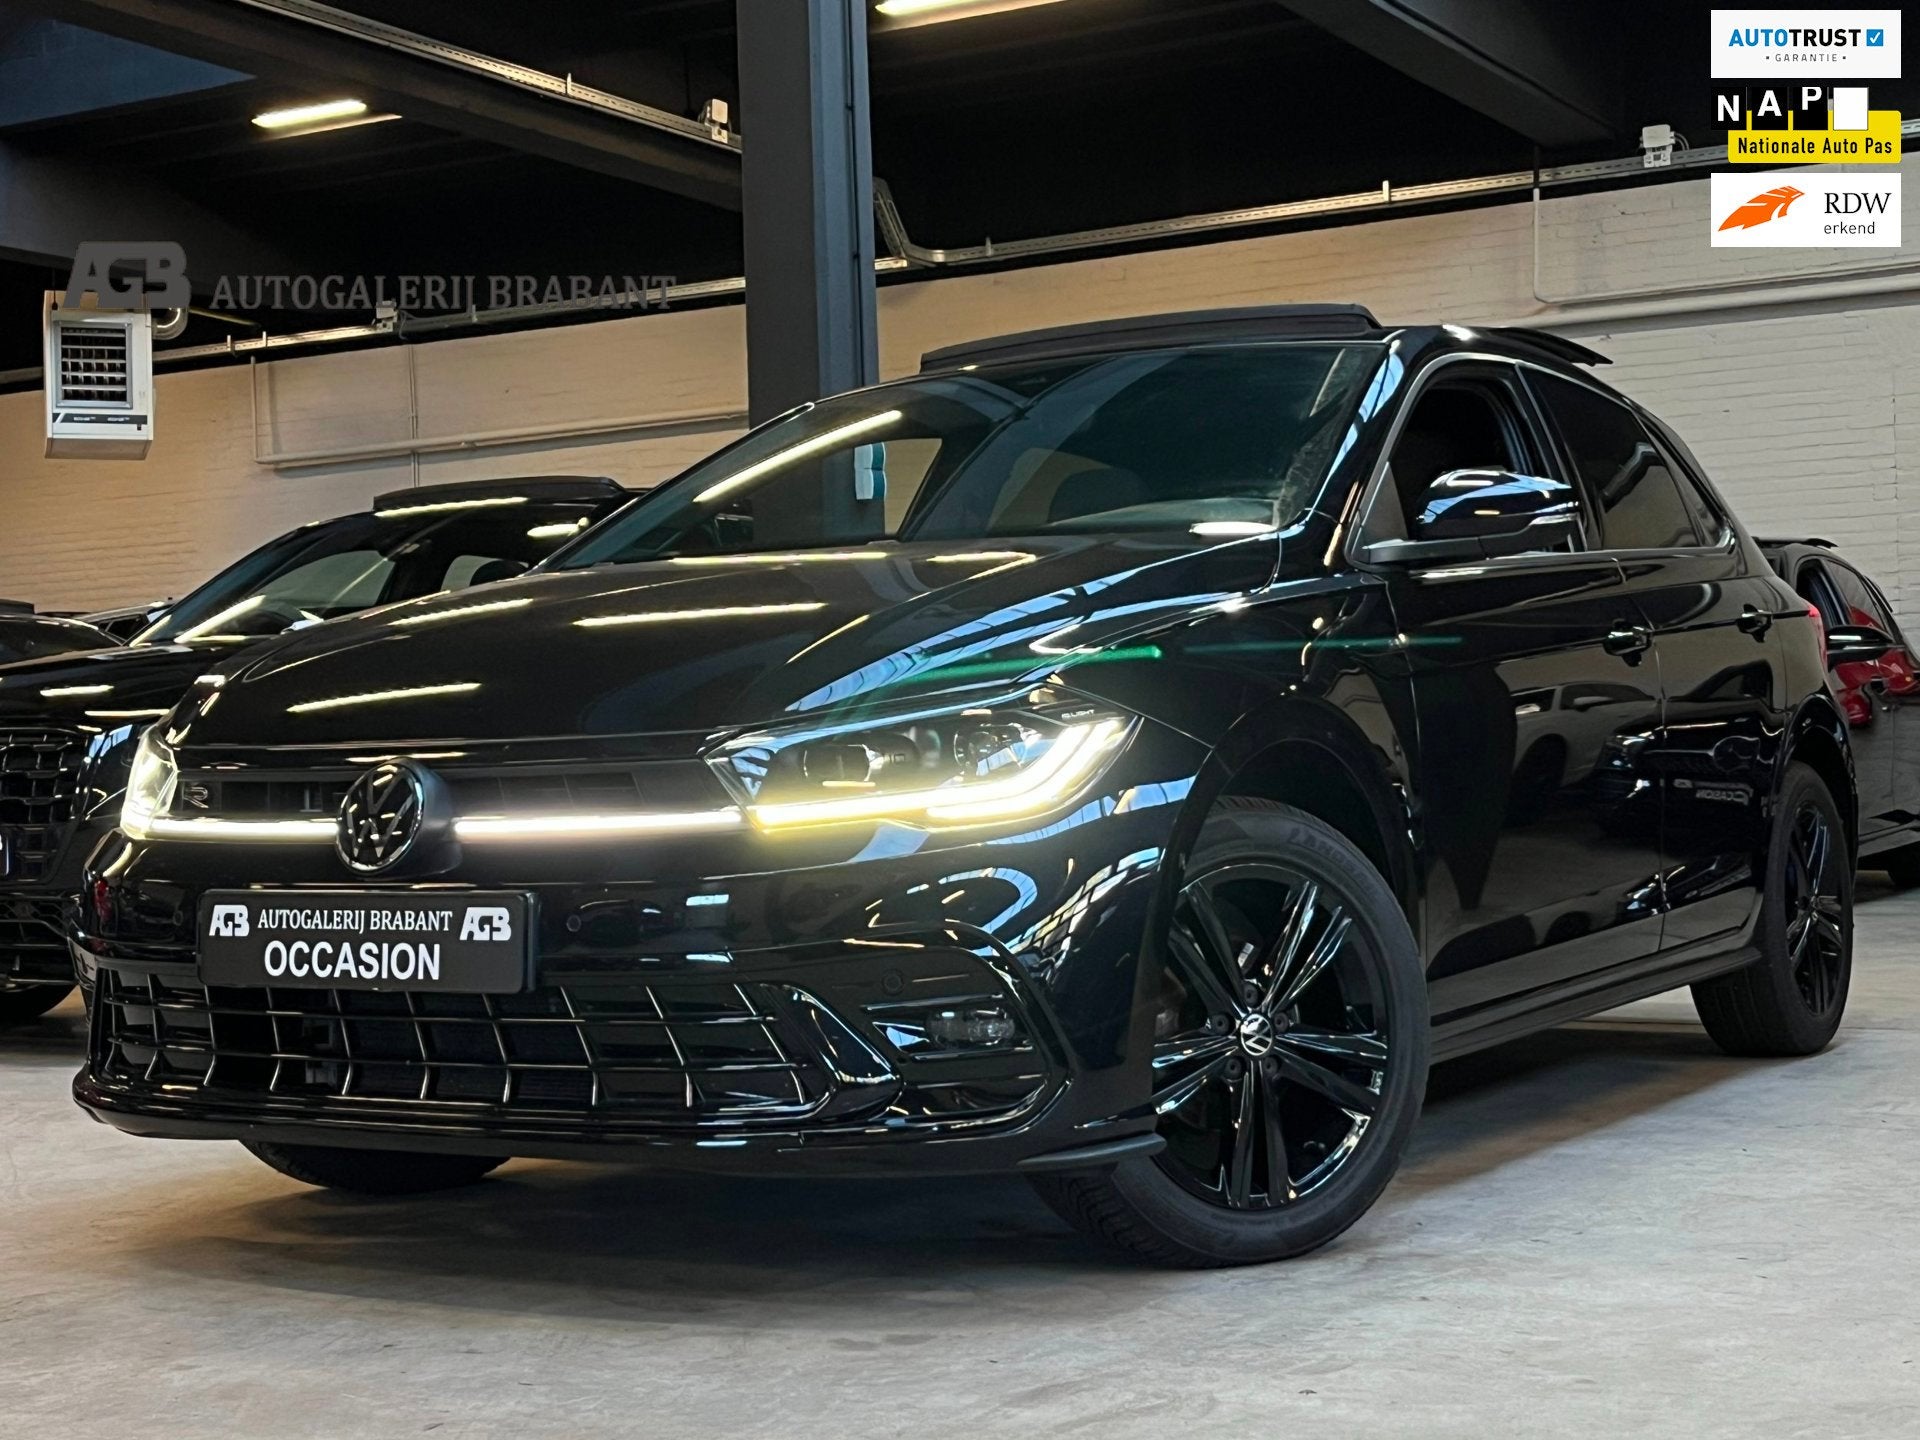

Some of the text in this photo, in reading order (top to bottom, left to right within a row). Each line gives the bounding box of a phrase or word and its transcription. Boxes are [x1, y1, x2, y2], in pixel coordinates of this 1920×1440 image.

[208, 904, 250, 937] AGB
[257, 909, 453, 934] AUTOGALERIJ BRABANT
[459, 906, 512, 941] AGB
[264, 940, 441, 981] OCCASION
